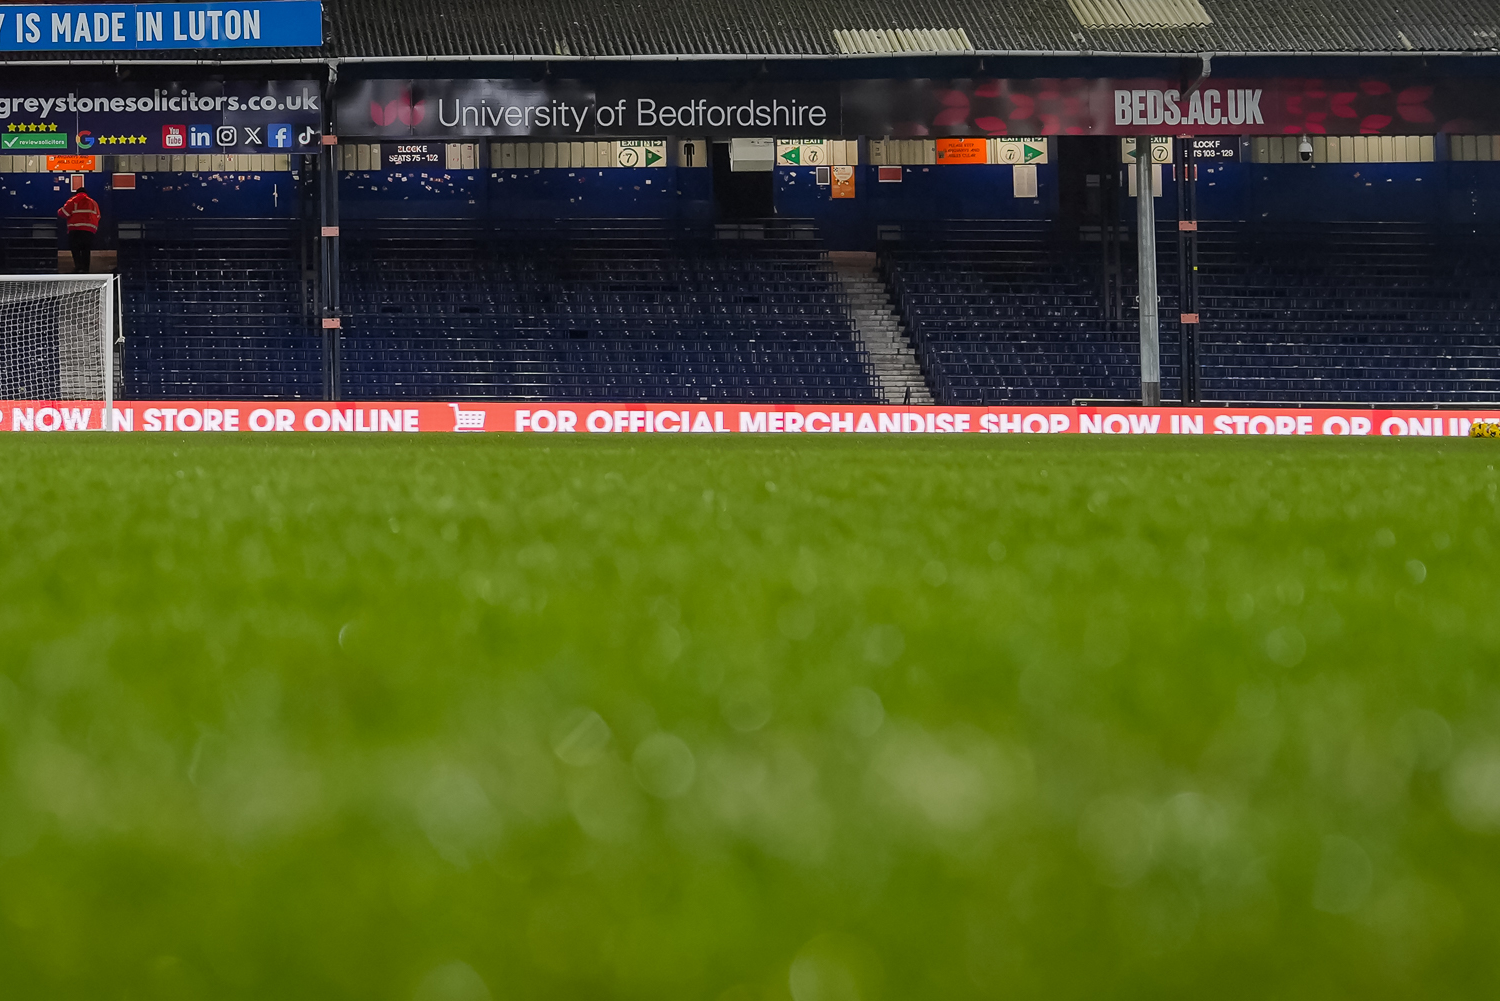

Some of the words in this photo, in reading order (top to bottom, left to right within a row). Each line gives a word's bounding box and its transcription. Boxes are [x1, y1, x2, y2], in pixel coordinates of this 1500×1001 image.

[16, 12, 41, 43] IS
[51, 12, 126, 43] MADE
[137, 11, 163, 42] IN
[173, 9, 261, 41] LUTON
[438, 98, 589, 133] University
[596, 99, 626, 127] of
[638, 98, 827, 127] Bedfordshire
[1114, 88, 1265, 126] BEDS.AC.UK
[166, 135, 183, 146] Tube
[169, 127, 180, 136] You
[19, 138, 65, 146] reviewsolicitors
[625, 153, 633, 163] 7
[1156, 149, 1164, 159] 7
[13, 407, 92, 432] NOW
[102, 408, 134, 432] IN
[143, 408, 239, 432] STORE
[248, 408, 296, 432] OR
[303, 408, 419, 432] ONLINE
[515, 410, 577, 433] FOR
[585, 410, 731, 433] OFFICIAL
[739, 411, 970, 433] MERCHANDISE
[979, 412, 1071, 434] SHOP
[1079, 413, 1161, 434] NOW
[1170, 414, 1205, 434] IN
[1213, 414, 1312, 435] STORE
[1322, 415, 1371, 435] OR
[1380, 416, 1500, 437] ONLIN
